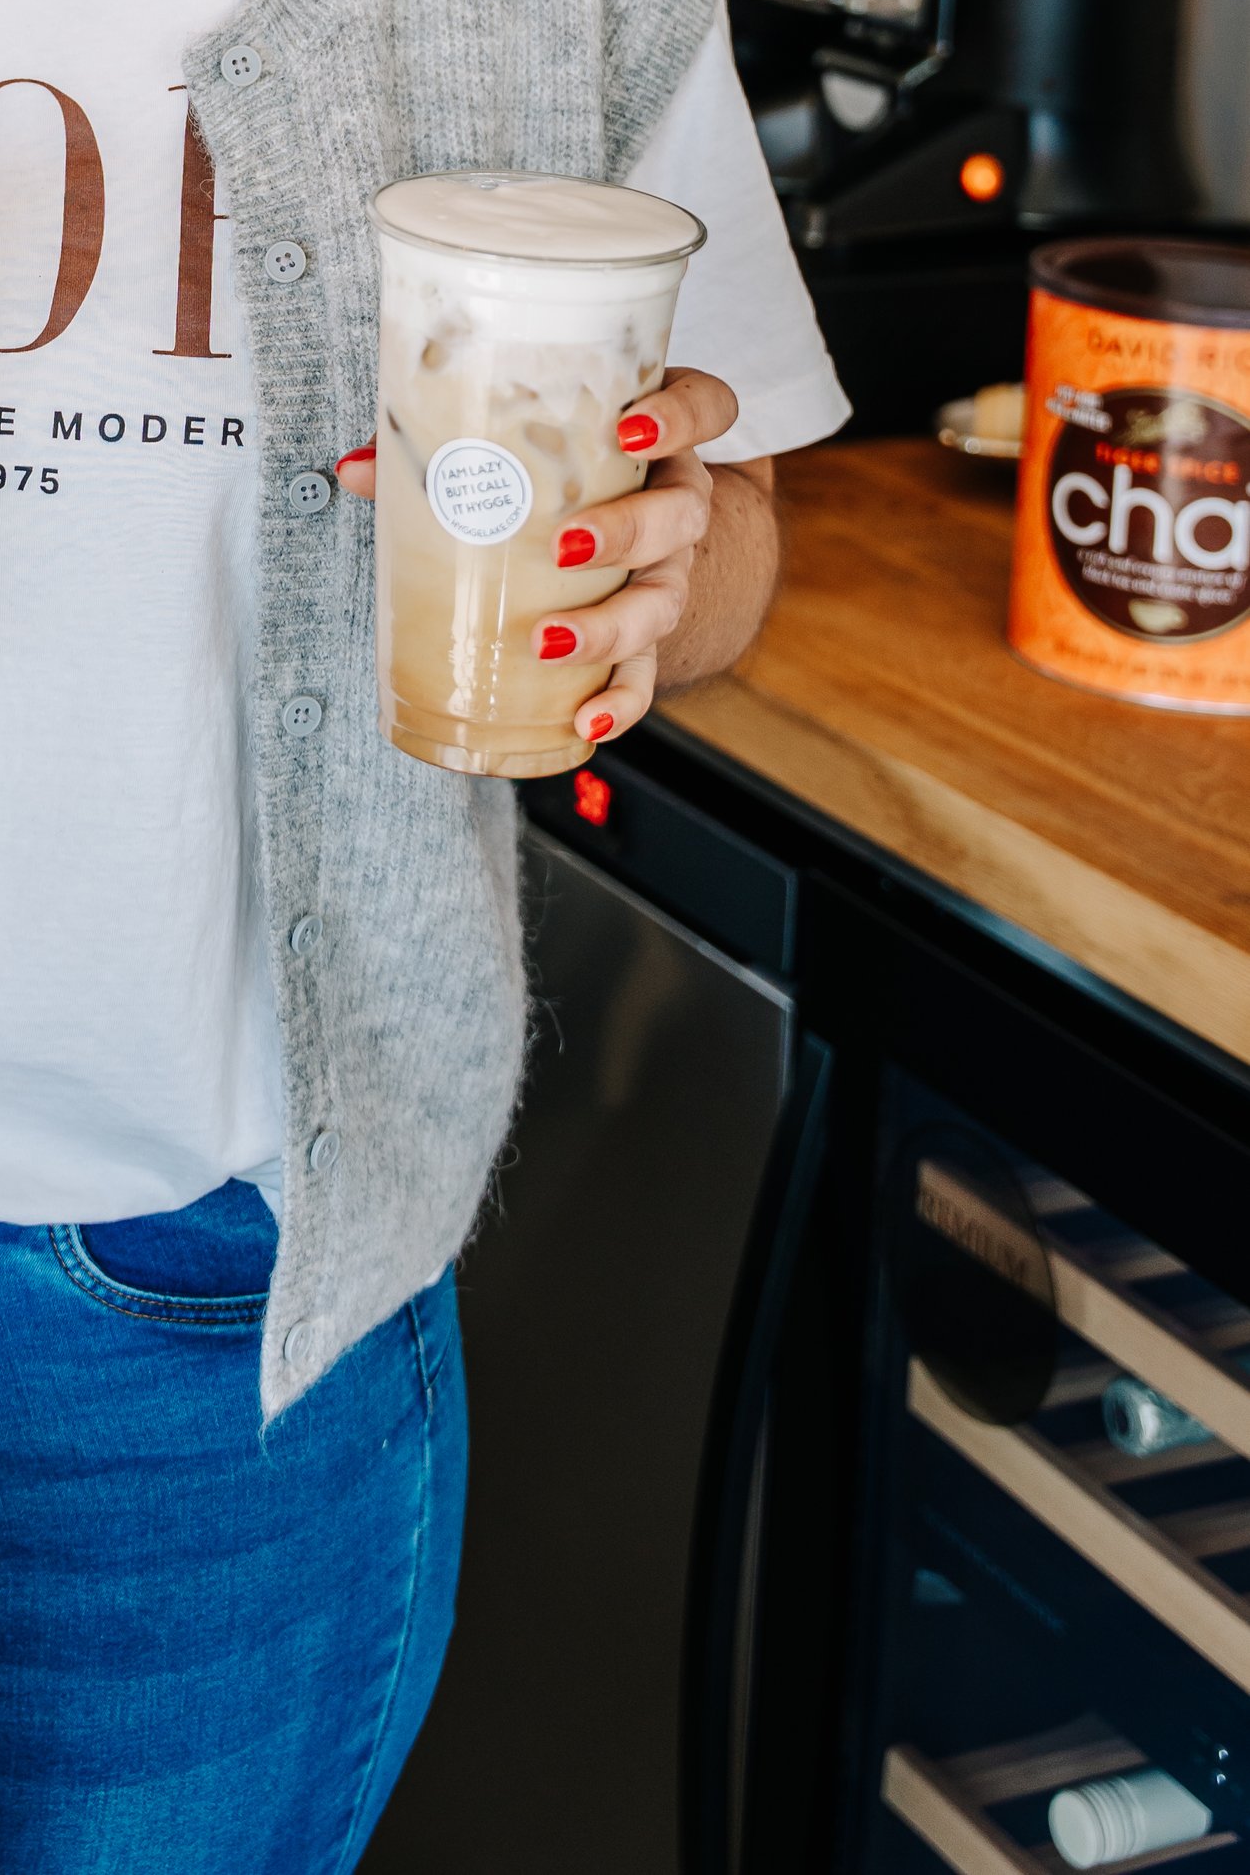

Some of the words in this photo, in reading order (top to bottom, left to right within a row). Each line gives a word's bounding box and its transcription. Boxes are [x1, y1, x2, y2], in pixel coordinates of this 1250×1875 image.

[51, 412, 246, 447] MODER
[441, 469, 447, 480] I
[448, 467, 467, 480] AM
[469, 460, 503, 477] LAZY
[445, 484, 469, 498] BUT
[470, 483, 476, 494] I
[476, 477, 512, 493] CALL
[452, 503, 464, 515] IT
[466, 494, 514, 513] HYGGE
[1052, 464, 1250, 572] cha
